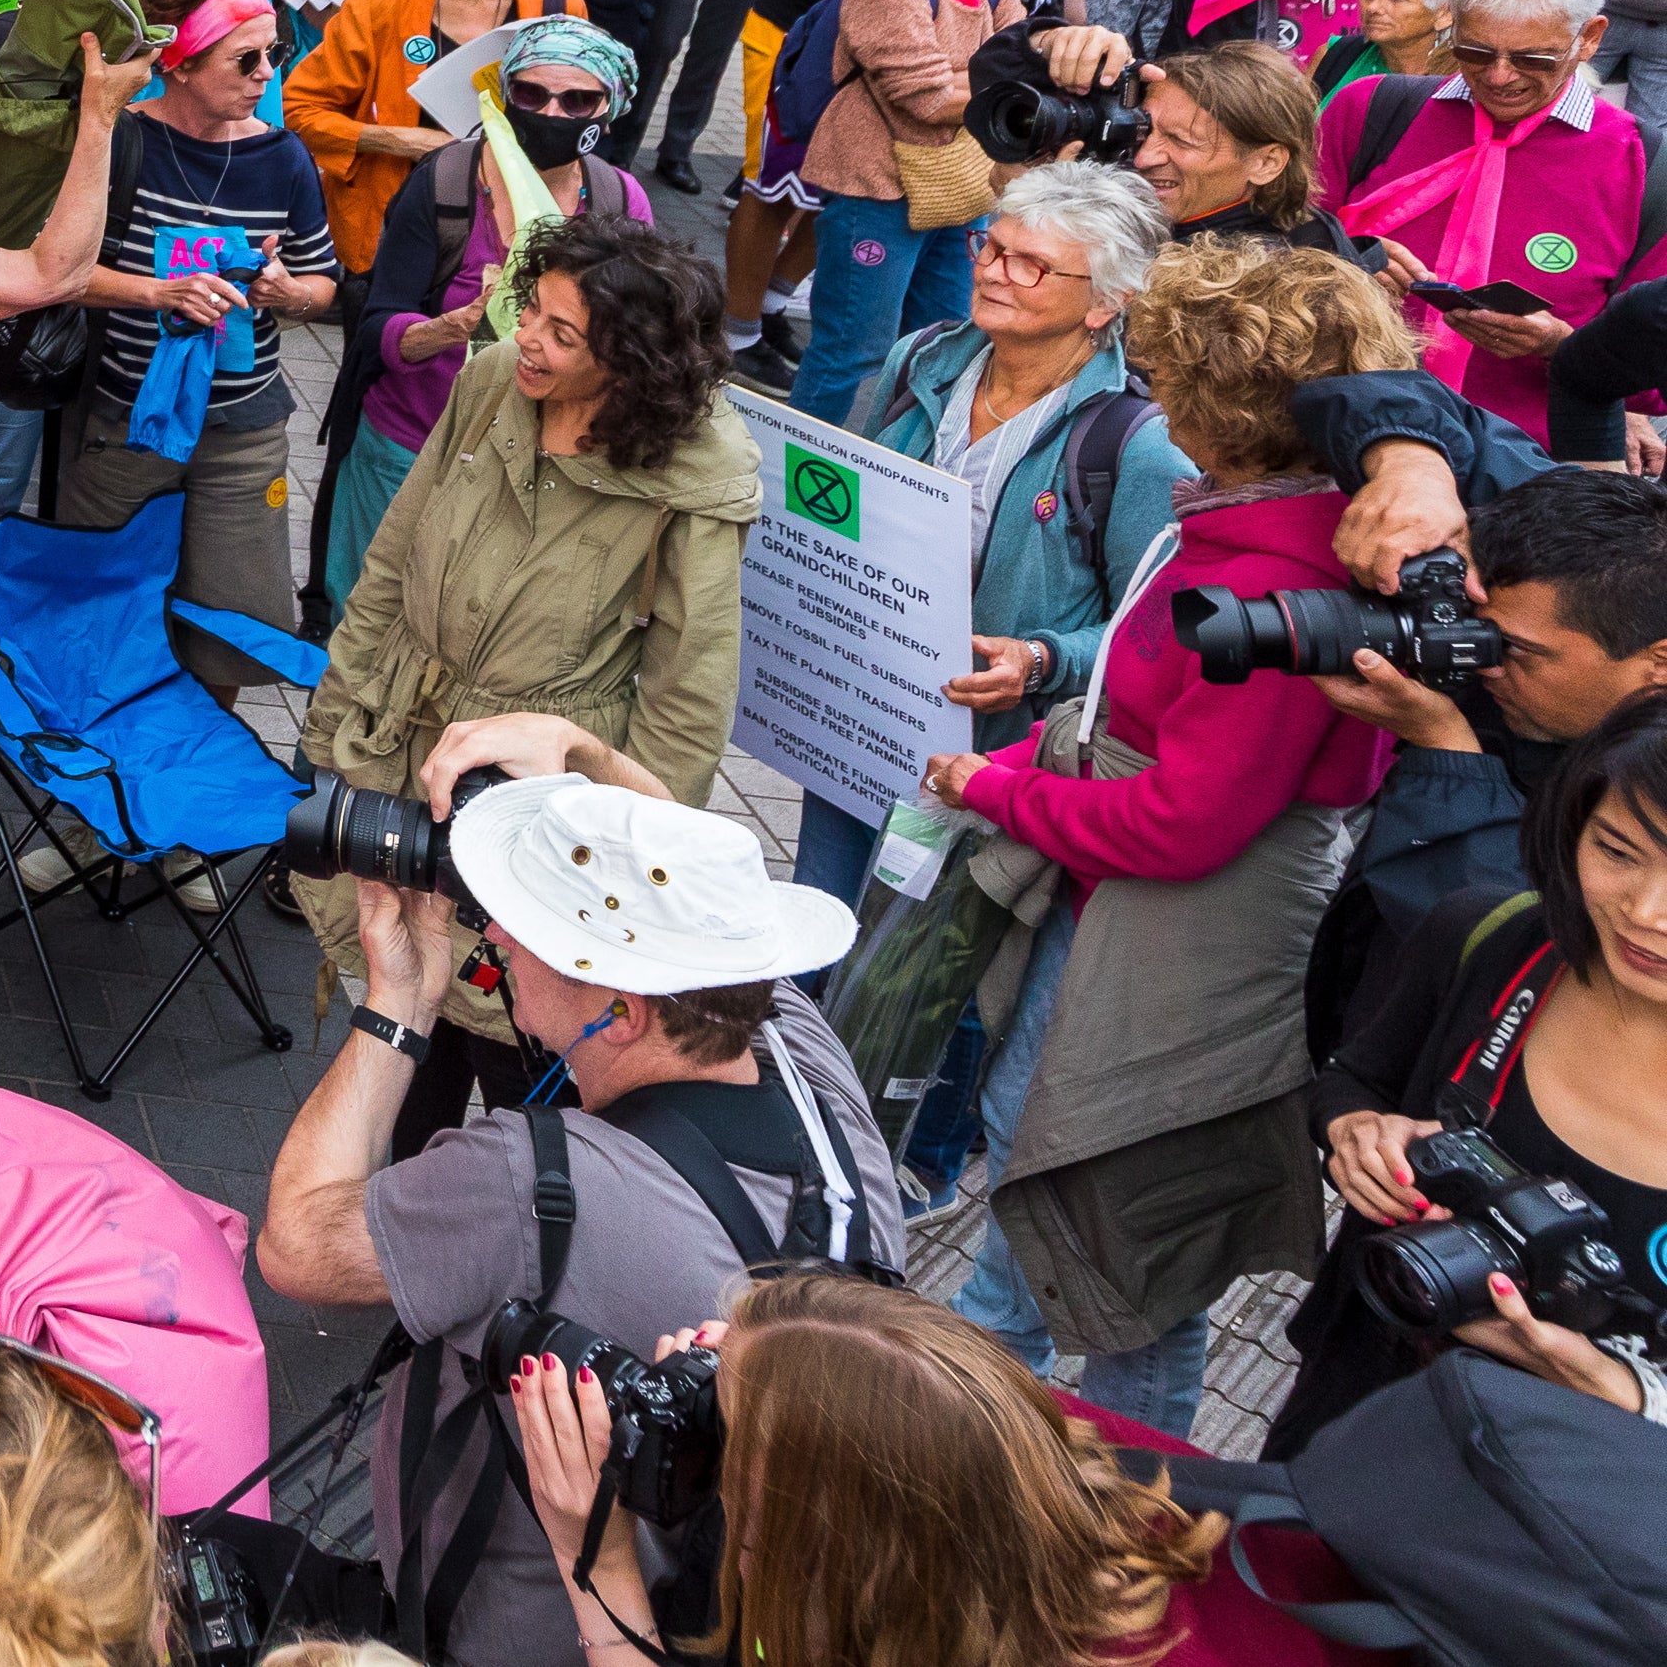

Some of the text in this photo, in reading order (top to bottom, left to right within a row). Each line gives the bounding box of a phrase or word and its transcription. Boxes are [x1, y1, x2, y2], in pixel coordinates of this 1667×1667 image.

[731, 400, 950, 503] TINCTION REBELLION GRANDPARENTS
[741, 557, 941, 662] CREASE RENEWABLE ENERGY
[761, 535, 906, 615] GRANDCHILDREN
[776, 521, 809, 548] THE
[812, 540, 859, 572] SAKE
[863, 564, 886, 583] OF
[891, 577, 931, 607] OUR
[740, 595, 944, 708] EMOVE FOSSIL FUEL SUBSIDIES
[798, 598, 868, 640] SUBSIDIES
[746, 629, 927, 733] TAX THE PLANET TRASHERS
[753, 679, 919, 777] PESTICIDE FREE FARMING
[755, 666, 917, 762] SUBSIDISE SUSTAINABLE
[742, 706, 902, 802] BAN CORPORATE FUNDIN
[774, 737, 839, 786] POLITICAL
[1479, 988, 1534, 1071] Canon
